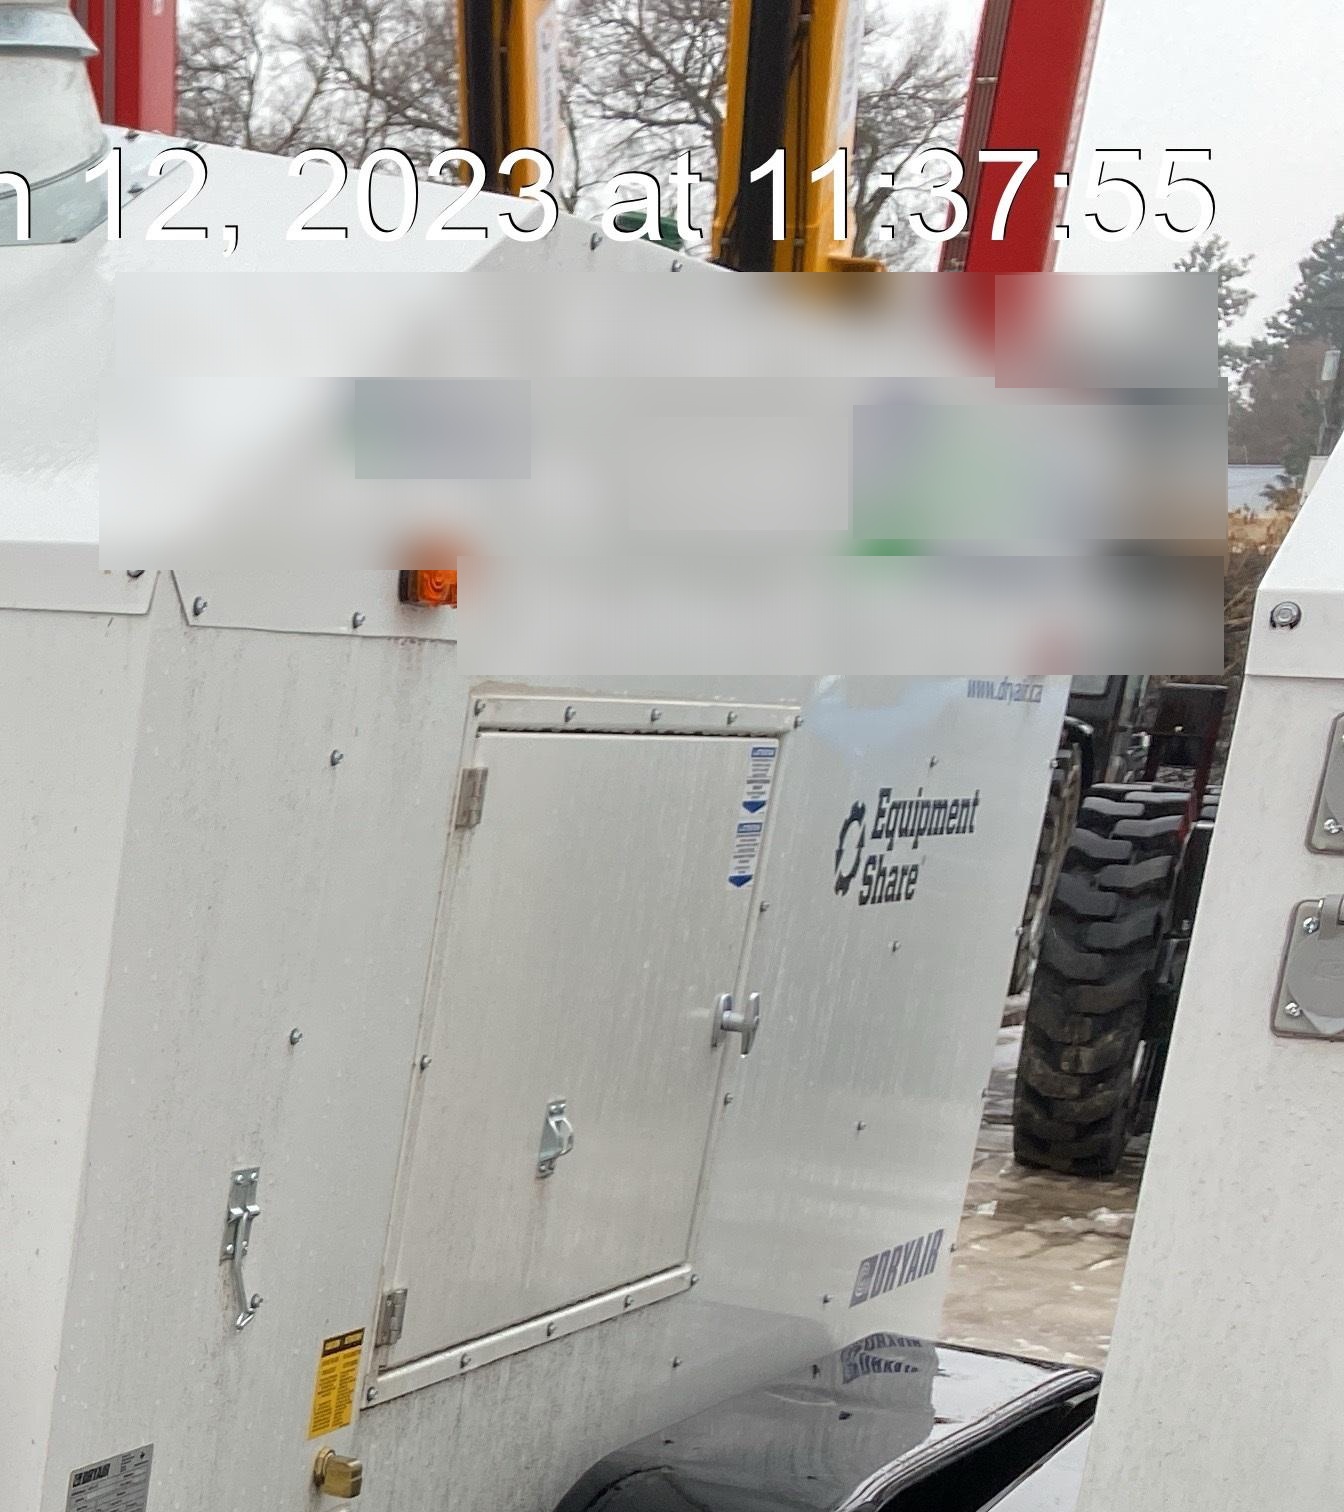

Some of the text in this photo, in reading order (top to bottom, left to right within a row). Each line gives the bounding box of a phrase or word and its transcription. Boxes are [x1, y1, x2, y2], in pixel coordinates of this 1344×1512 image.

[871, 787, 980, 851] Equipment
[858, 854, 919, 906] Share
[869, 1229, 944, 1299] DRYAIR
